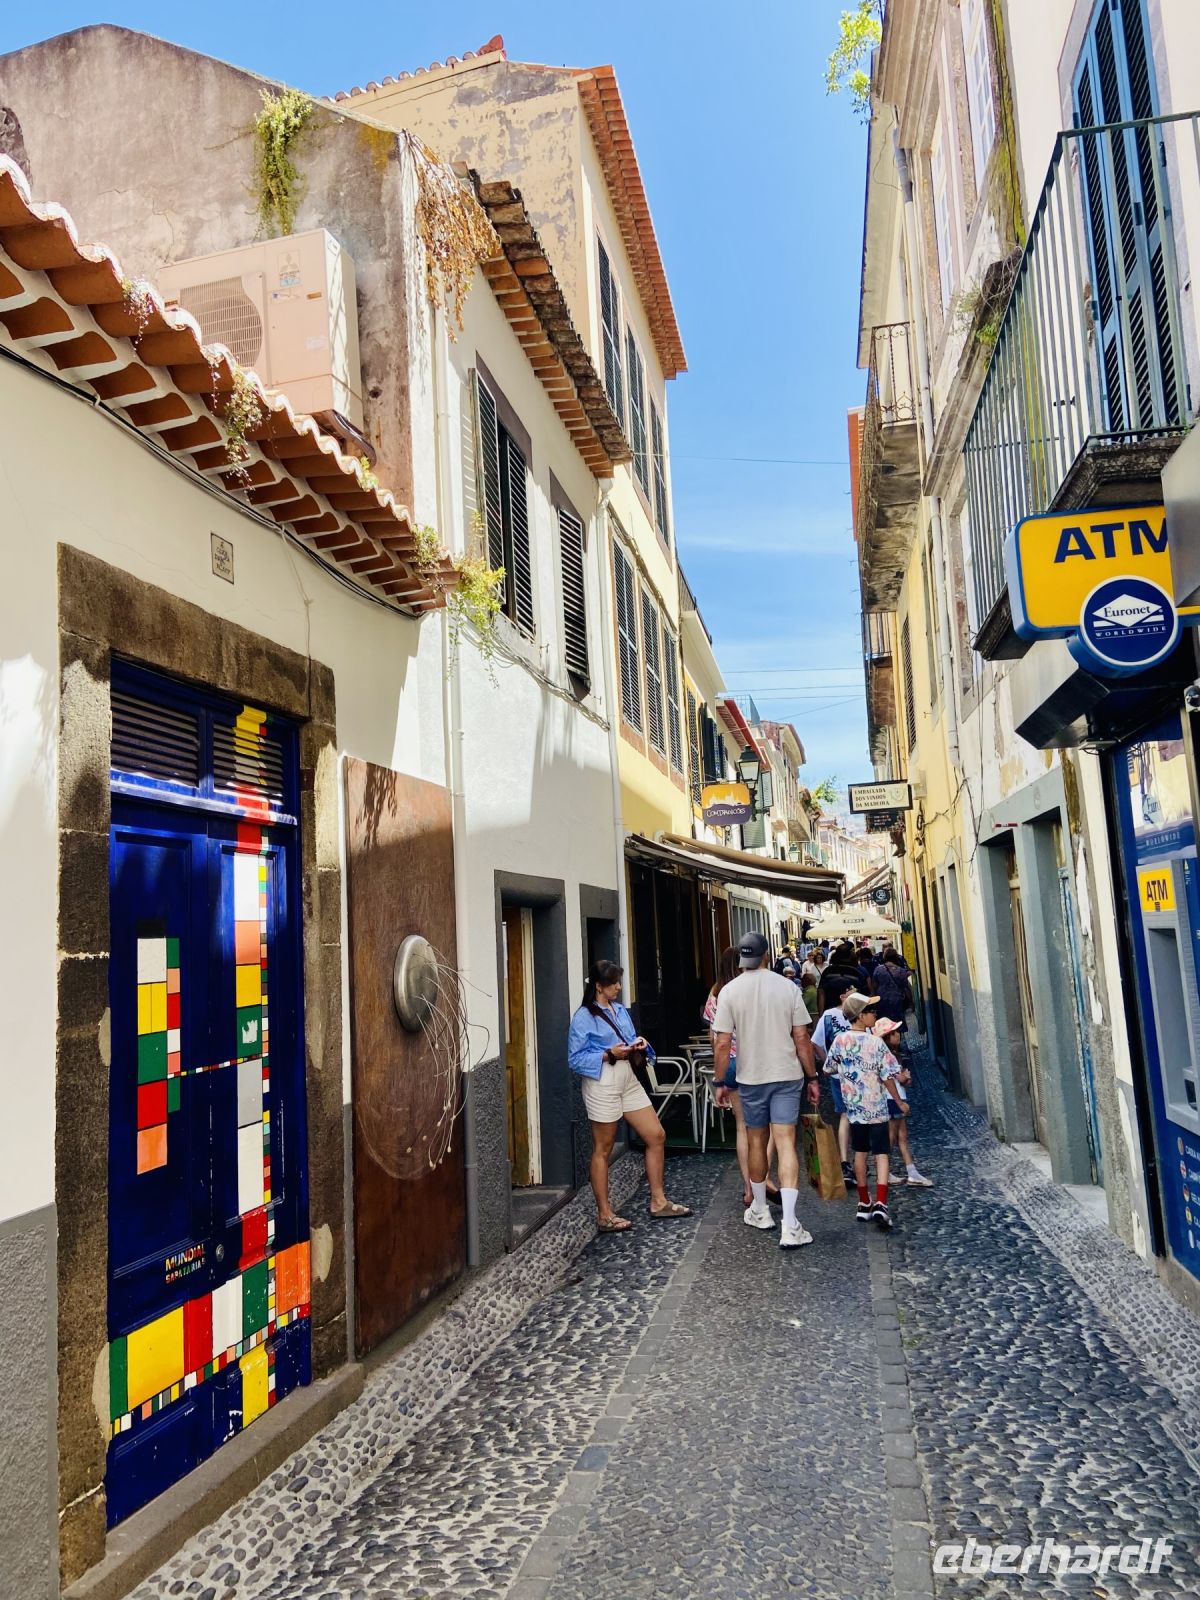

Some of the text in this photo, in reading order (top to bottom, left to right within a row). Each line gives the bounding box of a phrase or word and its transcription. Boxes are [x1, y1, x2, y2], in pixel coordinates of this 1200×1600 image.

[1054, 517, 1168, 563] ATM
[1103, 605, 1151, 618] Euronet
[1095, 626, 1167, 637] WORLDWIDE
[854, 787, 887, 795] EMBAIXADA
[1146, 878, 1168, 901] ATM
[165, 1243, 205, 1272] MUNDIAL
[165, 1257, 205, 1284] SAPATARIAS
